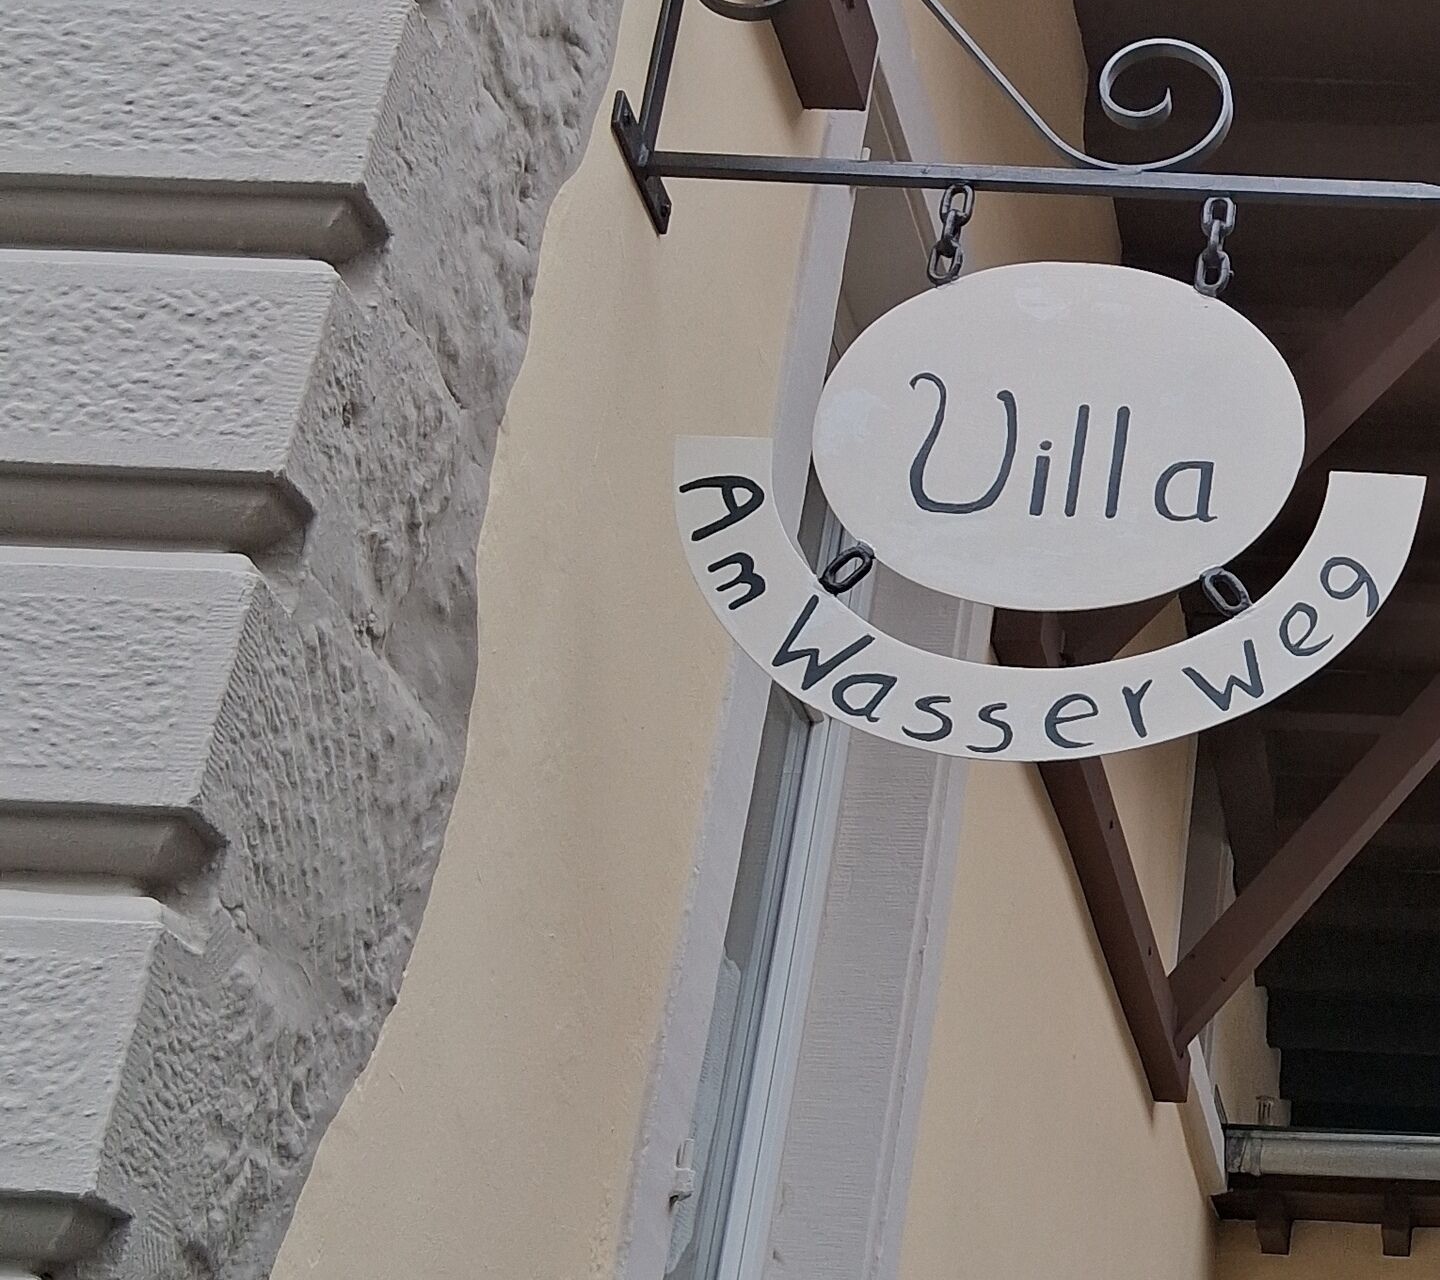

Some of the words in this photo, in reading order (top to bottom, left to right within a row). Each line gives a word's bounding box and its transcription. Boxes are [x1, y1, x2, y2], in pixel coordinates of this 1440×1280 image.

[908, 371, 1219, 524] Villa
[678, 474, 767, 612] Am
[770, 555, 1382, 754] Wasserweg
